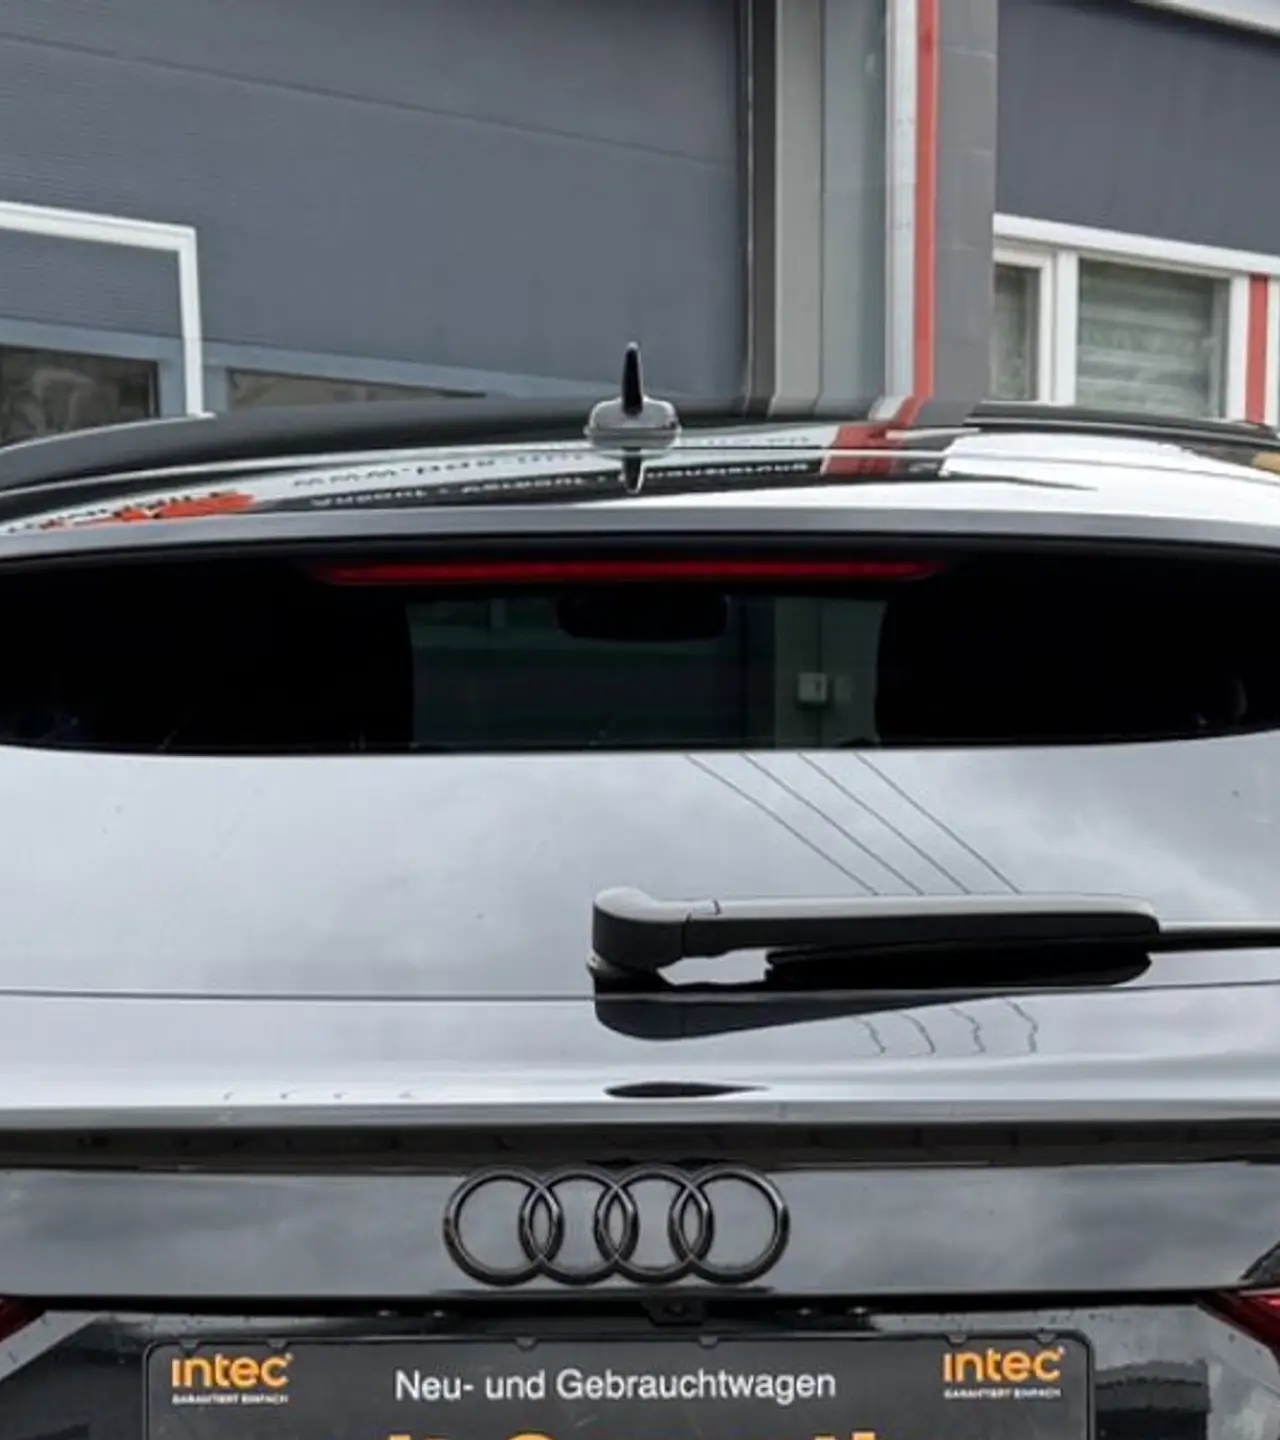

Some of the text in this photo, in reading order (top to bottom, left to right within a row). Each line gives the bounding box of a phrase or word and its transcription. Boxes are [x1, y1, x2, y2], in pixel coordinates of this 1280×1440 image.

[172, 1352, 291, 1389] intec
[943, 1347, 1063, 1383] intec
[395, 1368, 837, 1405] Neu- und Gebrauchtwagen
